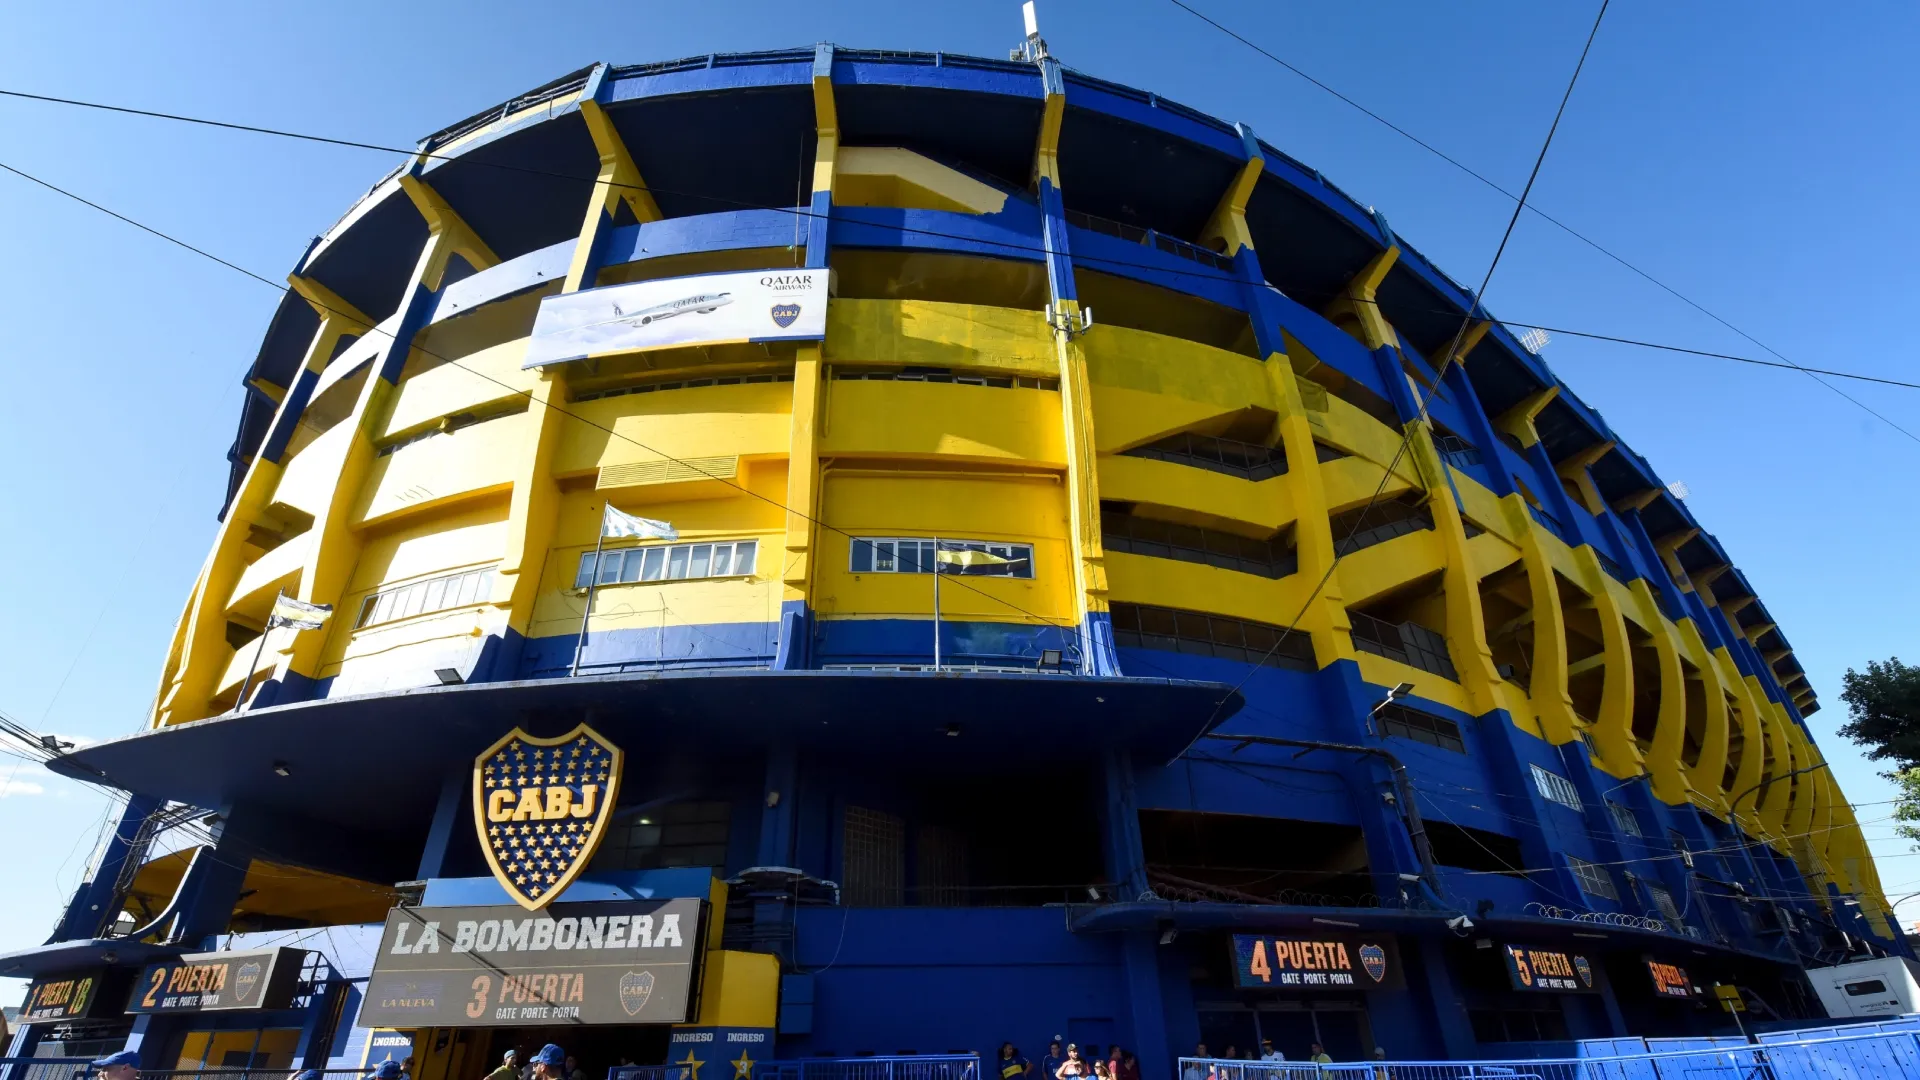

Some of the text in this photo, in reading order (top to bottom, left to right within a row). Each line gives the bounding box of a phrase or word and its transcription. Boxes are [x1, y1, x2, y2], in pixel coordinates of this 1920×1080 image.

[760, 275, 812, 287] QATAR
[673, 295, 705, 309] QATAR
[488, 784, 598, 823] CABJ
[390, 913, 683, 954] LA BOMBONERA
[1251, 940, 1352, 982] 4 PUERTA
[1513, 949, 1574, 987] 5 PUERTA
[141, 963, 229, 1008] 2 PUERTA
[1281, 973, 1354, 985] GATE PORTE PORTA
[466, 973, 584, 1019] 3 PUERTA
[622, 985, 649, 996] CABJ
[24, 984, 41, 1019] 1
[36, 980, 75, 1007] PUERTA
[162, 994, 220, 1008] GATE PORTE PORTA
[382, 998, 435, 1008] LA NUEVA
[495, 1006, 580, 1020] GATE PORTE PORTA
[372, 1036, 413, 1047] INGRESO
[672, 1033, 714, 1043] INGRESO
[727, 1033, 765, 1043] INGRESO
[738, 1061, 748, 1074] 3
